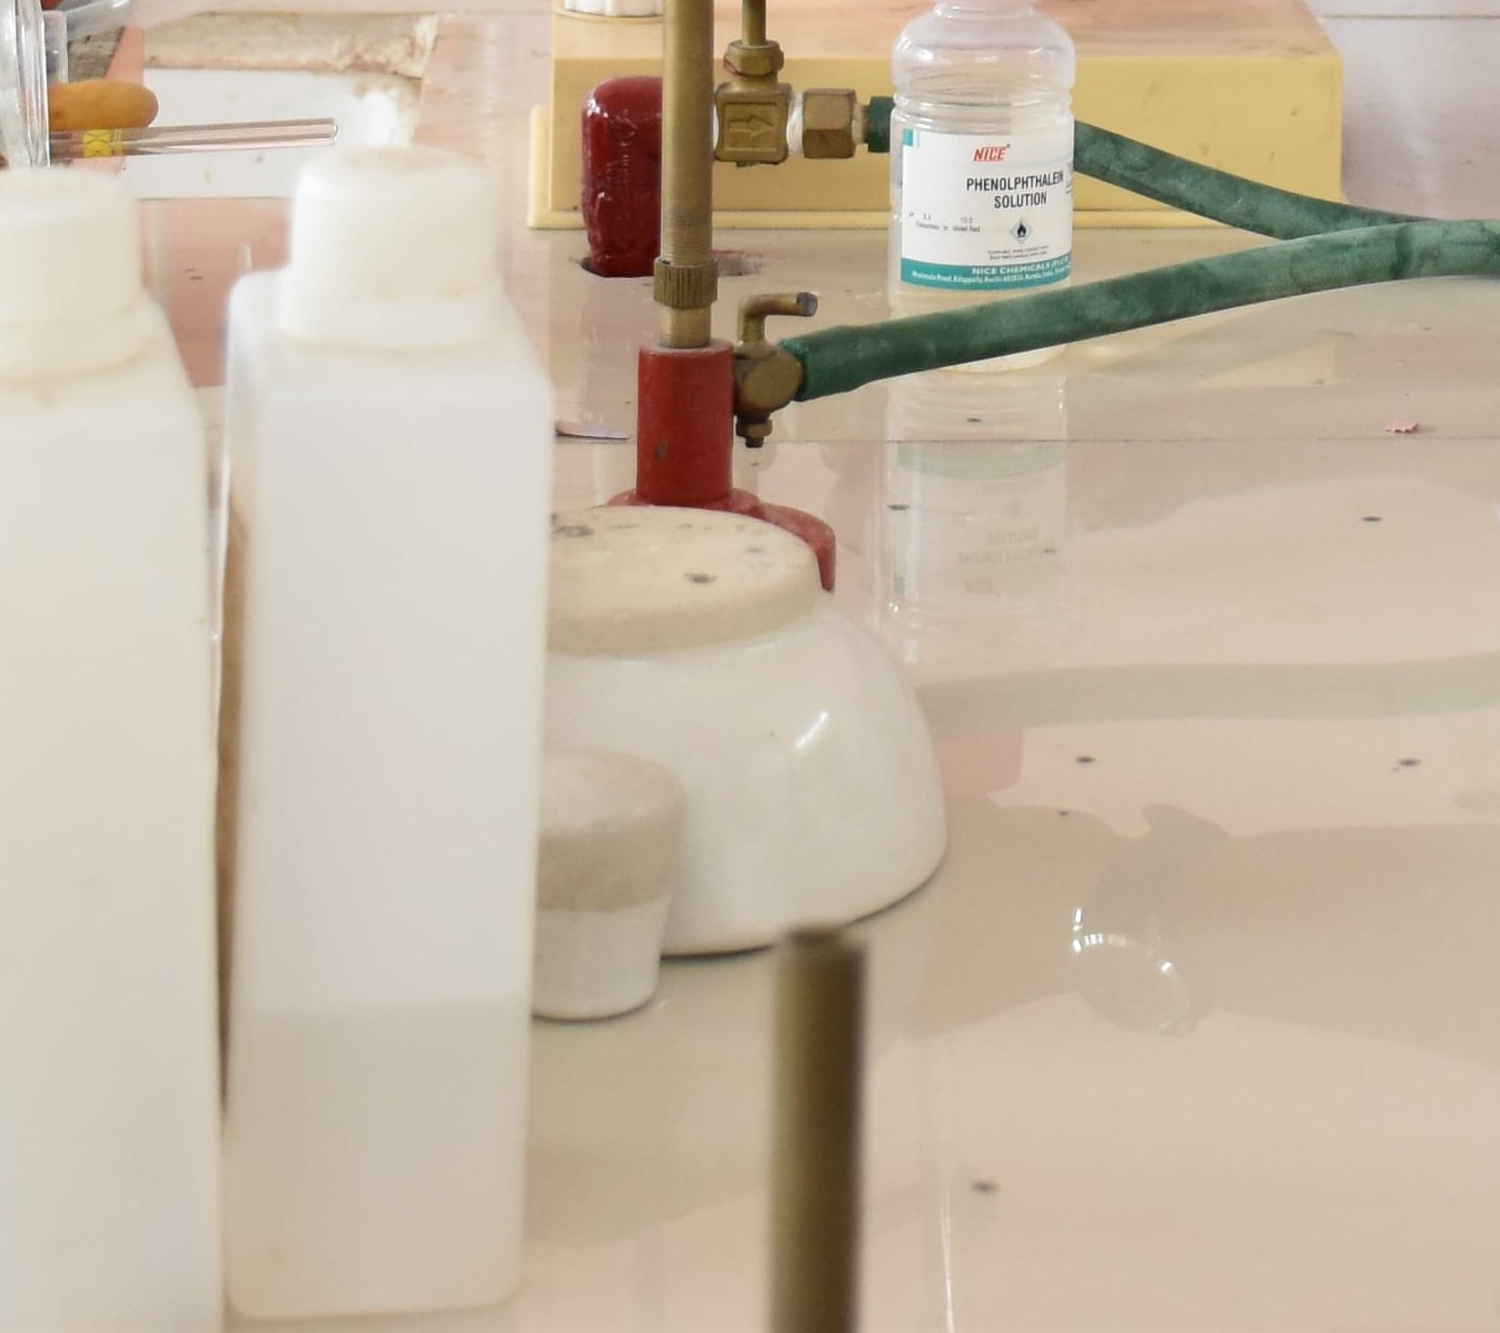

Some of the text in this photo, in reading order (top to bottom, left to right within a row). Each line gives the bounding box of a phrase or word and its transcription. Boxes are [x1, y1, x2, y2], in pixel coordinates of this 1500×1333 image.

[973, 146, 1006, 162] NICE
[966, 170, 1064, 192] PHENOLPHTHALEIN
[994, 192, 1047, 209] SOLUTION
[972, 267, 997, 276] NICE
